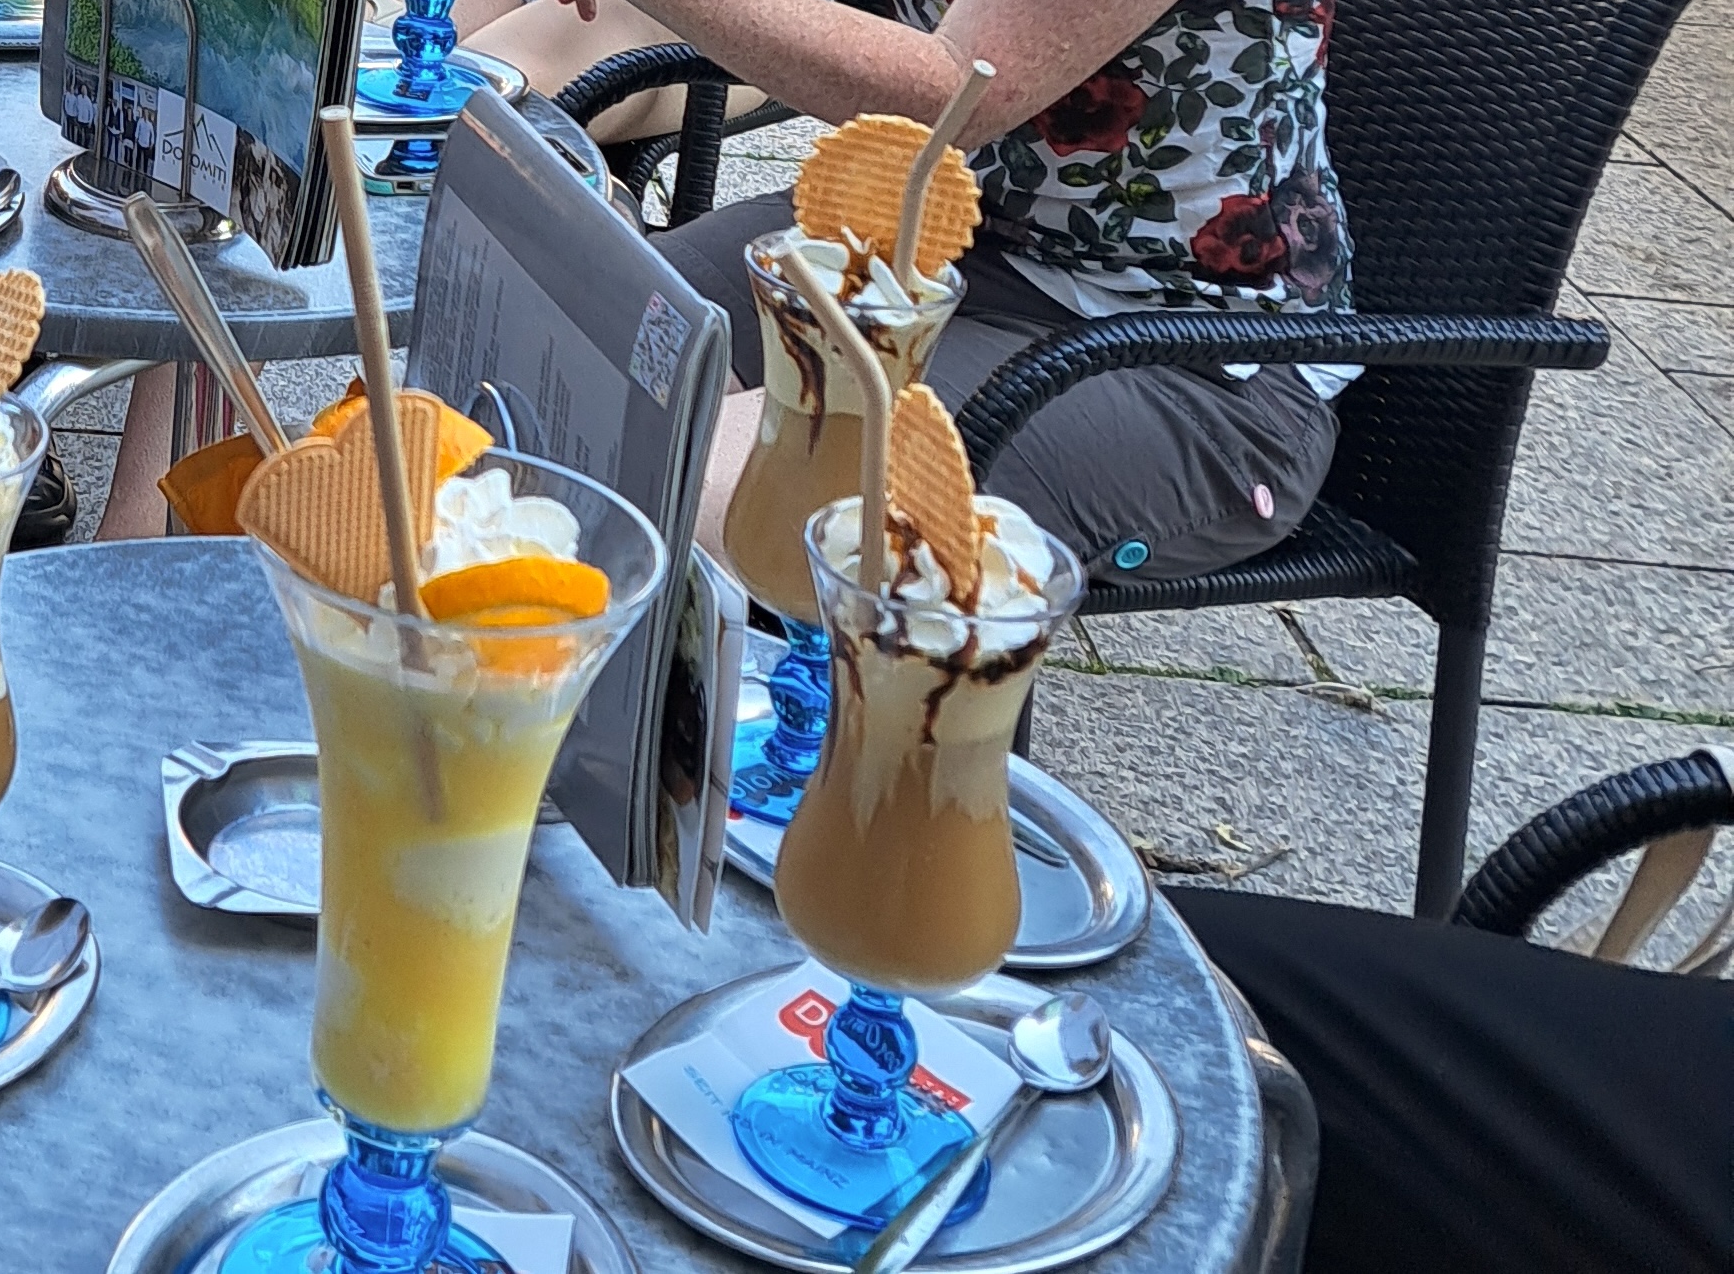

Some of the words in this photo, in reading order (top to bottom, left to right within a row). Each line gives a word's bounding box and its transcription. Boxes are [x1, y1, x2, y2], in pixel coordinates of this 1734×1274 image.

[162, 138, 227, 185] DOOMITI
[680, 1063, 724, 1107] SEIT
[785, 1146, 852, 1190] MAINZ
